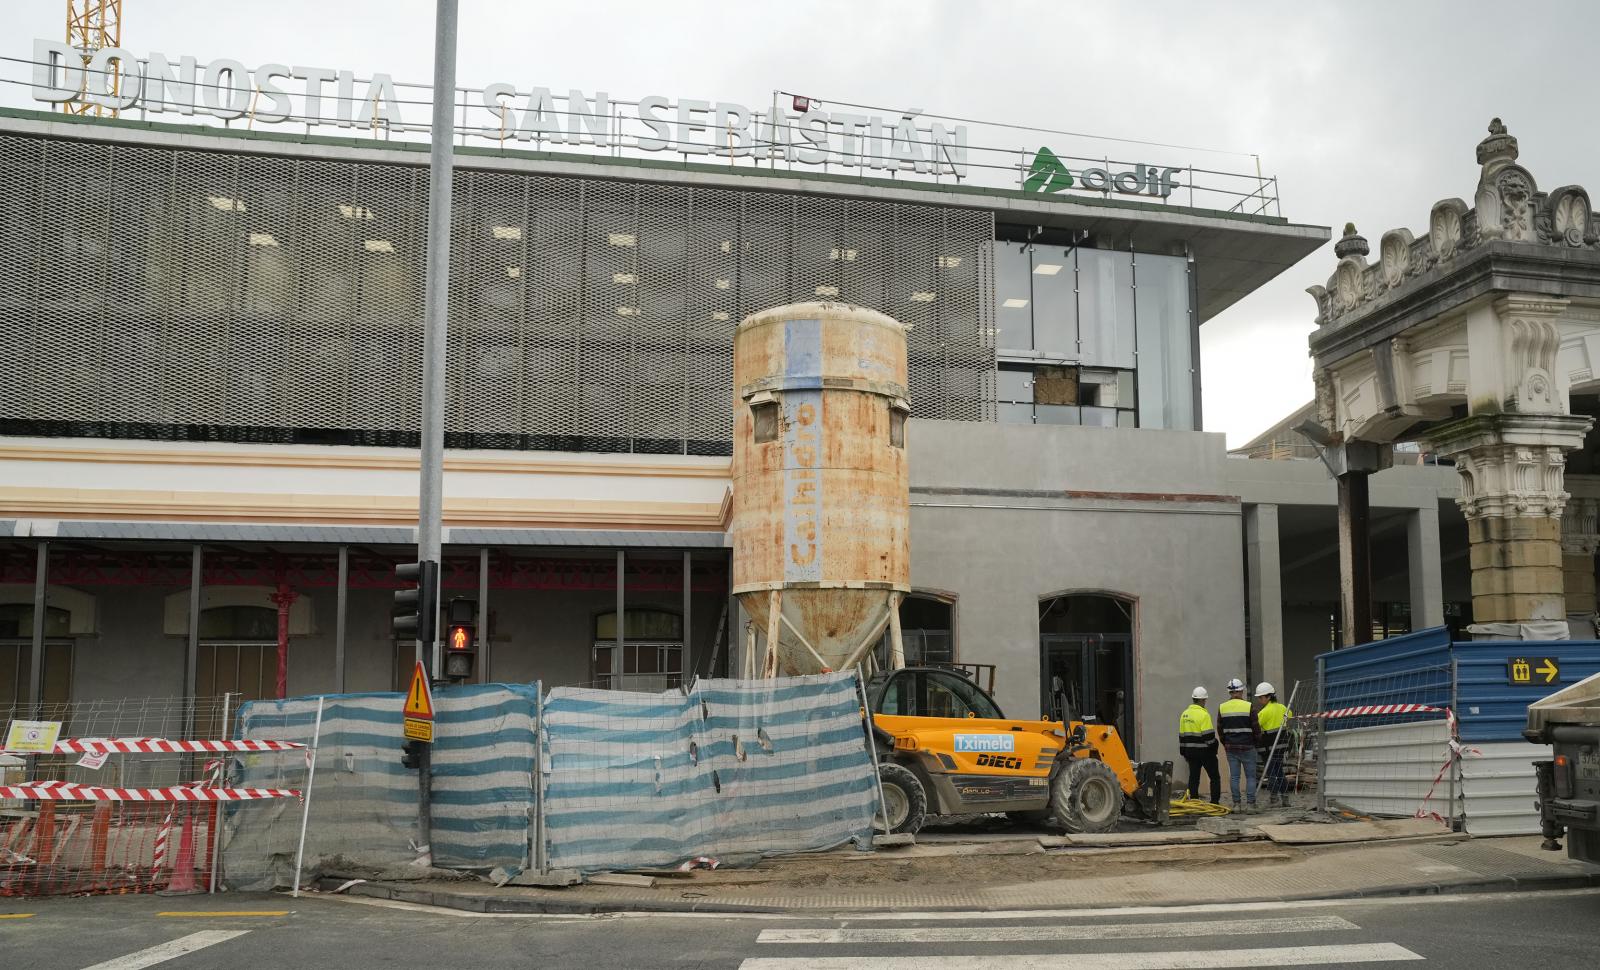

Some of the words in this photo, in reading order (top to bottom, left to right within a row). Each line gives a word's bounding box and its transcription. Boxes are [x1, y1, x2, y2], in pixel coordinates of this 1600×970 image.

[32, 38, 405, 132] DONOSTIA
[482, 82, 609, 147] SAN
[637, 95, 968, 178] SEBASTIÁN
[1080, 163, 1182, 196] adif
[957, 735, 1013, 750] Tximela
